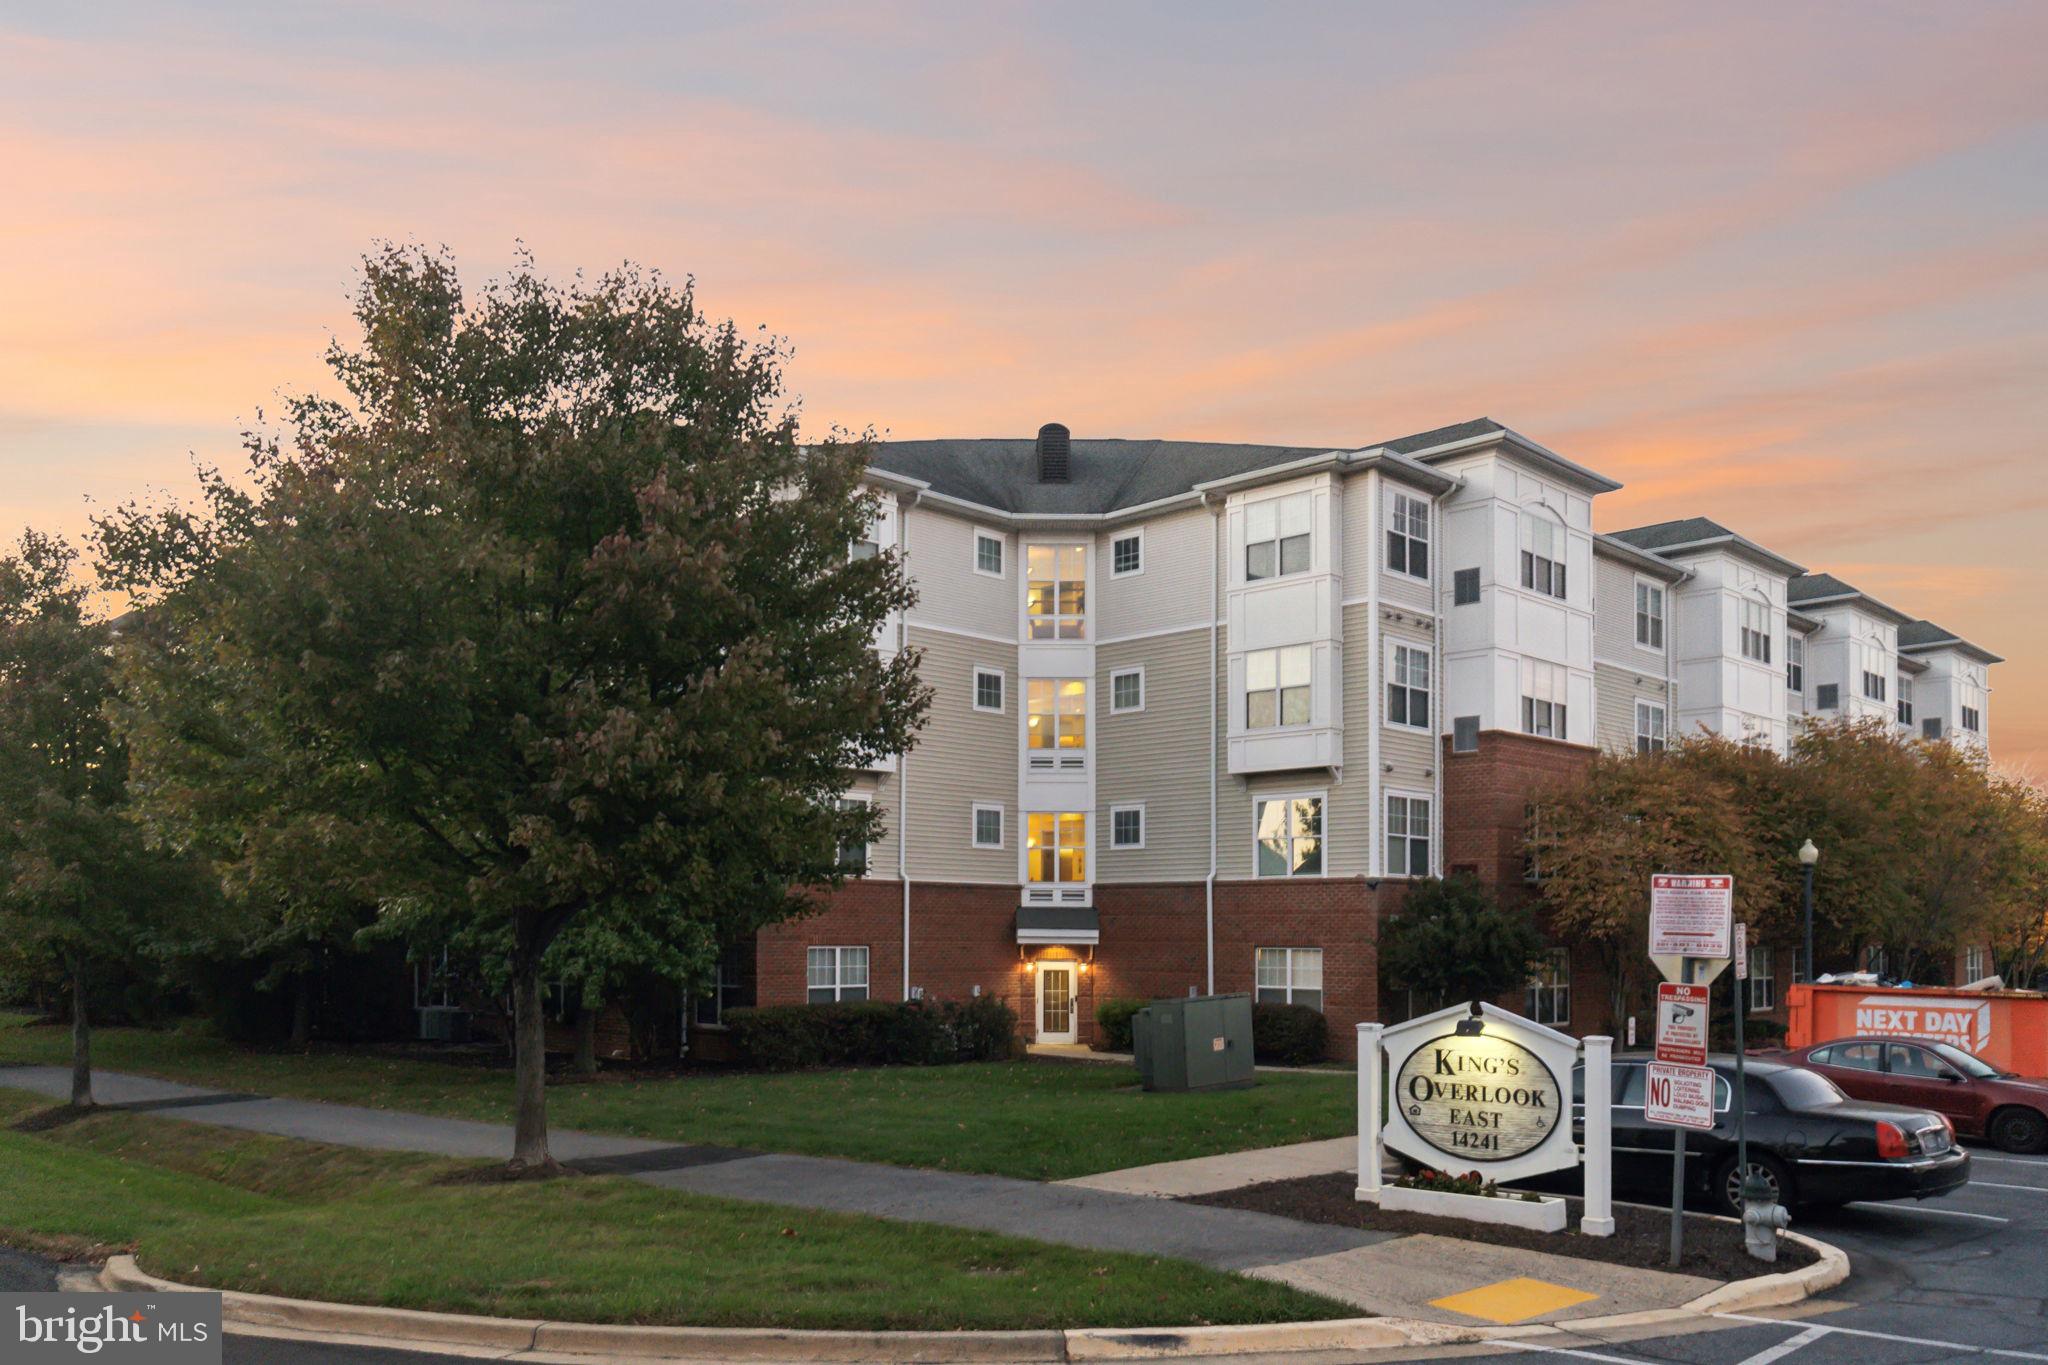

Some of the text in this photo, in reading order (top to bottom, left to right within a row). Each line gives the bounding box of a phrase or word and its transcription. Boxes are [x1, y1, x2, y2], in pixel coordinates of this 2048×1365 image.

[1670, 879, 1707, 888] WARNING
[1661, 994, 1707, 1003] TRESPASSING
[1676, 987, 1691, 995] NO
[1856, 1009, 1973, 1033] NEXT DAY
[1434, 1048, 1520, 1076] KING'S
[1652, 1066, 1709, 1078] PRIVATE PROPERTY
[1408, 1075, 1547, 1108] OVERLOOK
[1650, 1077, 1671, 1107] NO
[1674, 1080, 1702, 1088] SOLICITING
[1450, 1108, 1503, 1128] EAST
[1451, 1131, 1500, 1151] 14241
